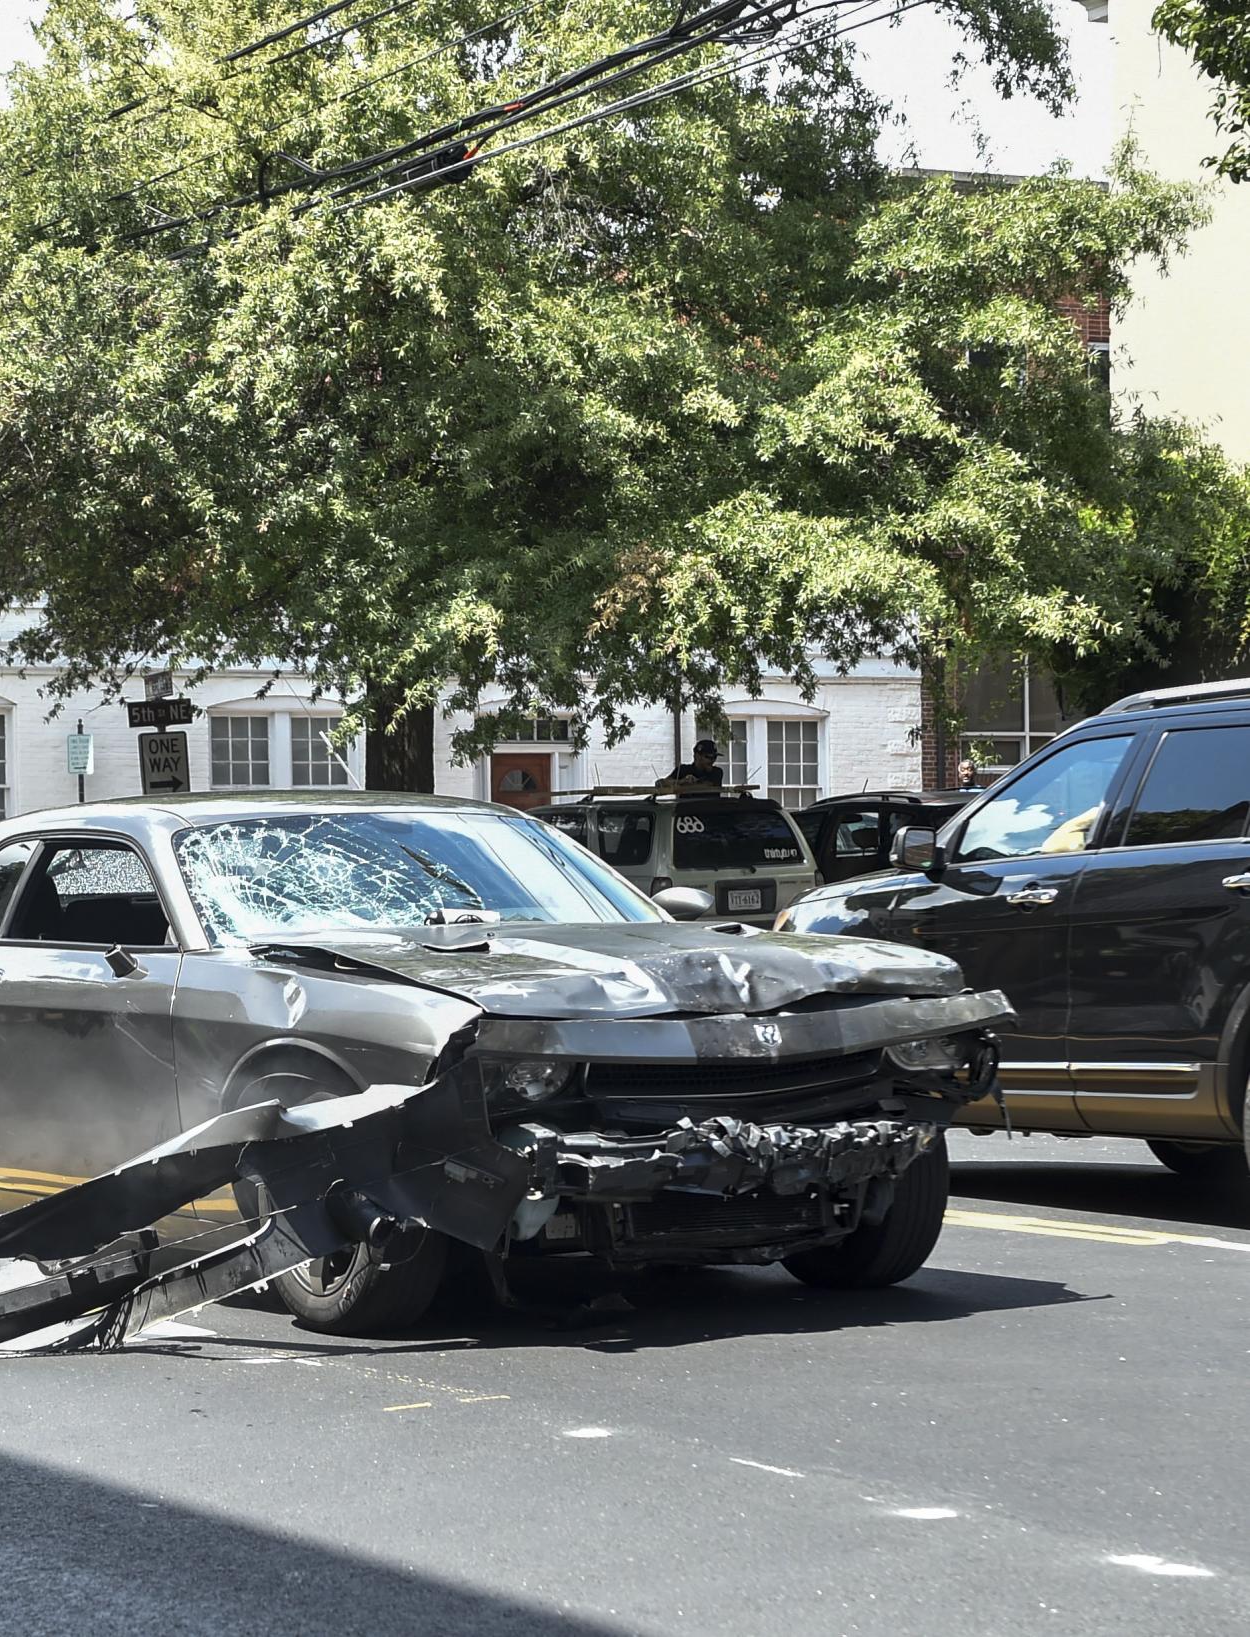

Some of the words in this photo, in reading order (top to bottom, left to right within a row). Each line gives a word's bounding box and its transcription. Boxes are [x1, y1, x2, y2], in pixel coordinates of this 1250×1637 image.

[132, 707, 155, 723] 5th
[170, 703, 189, 720] NE
[149, 738, 180, 754] ONE
[149, 756, 181, 773] WAY
